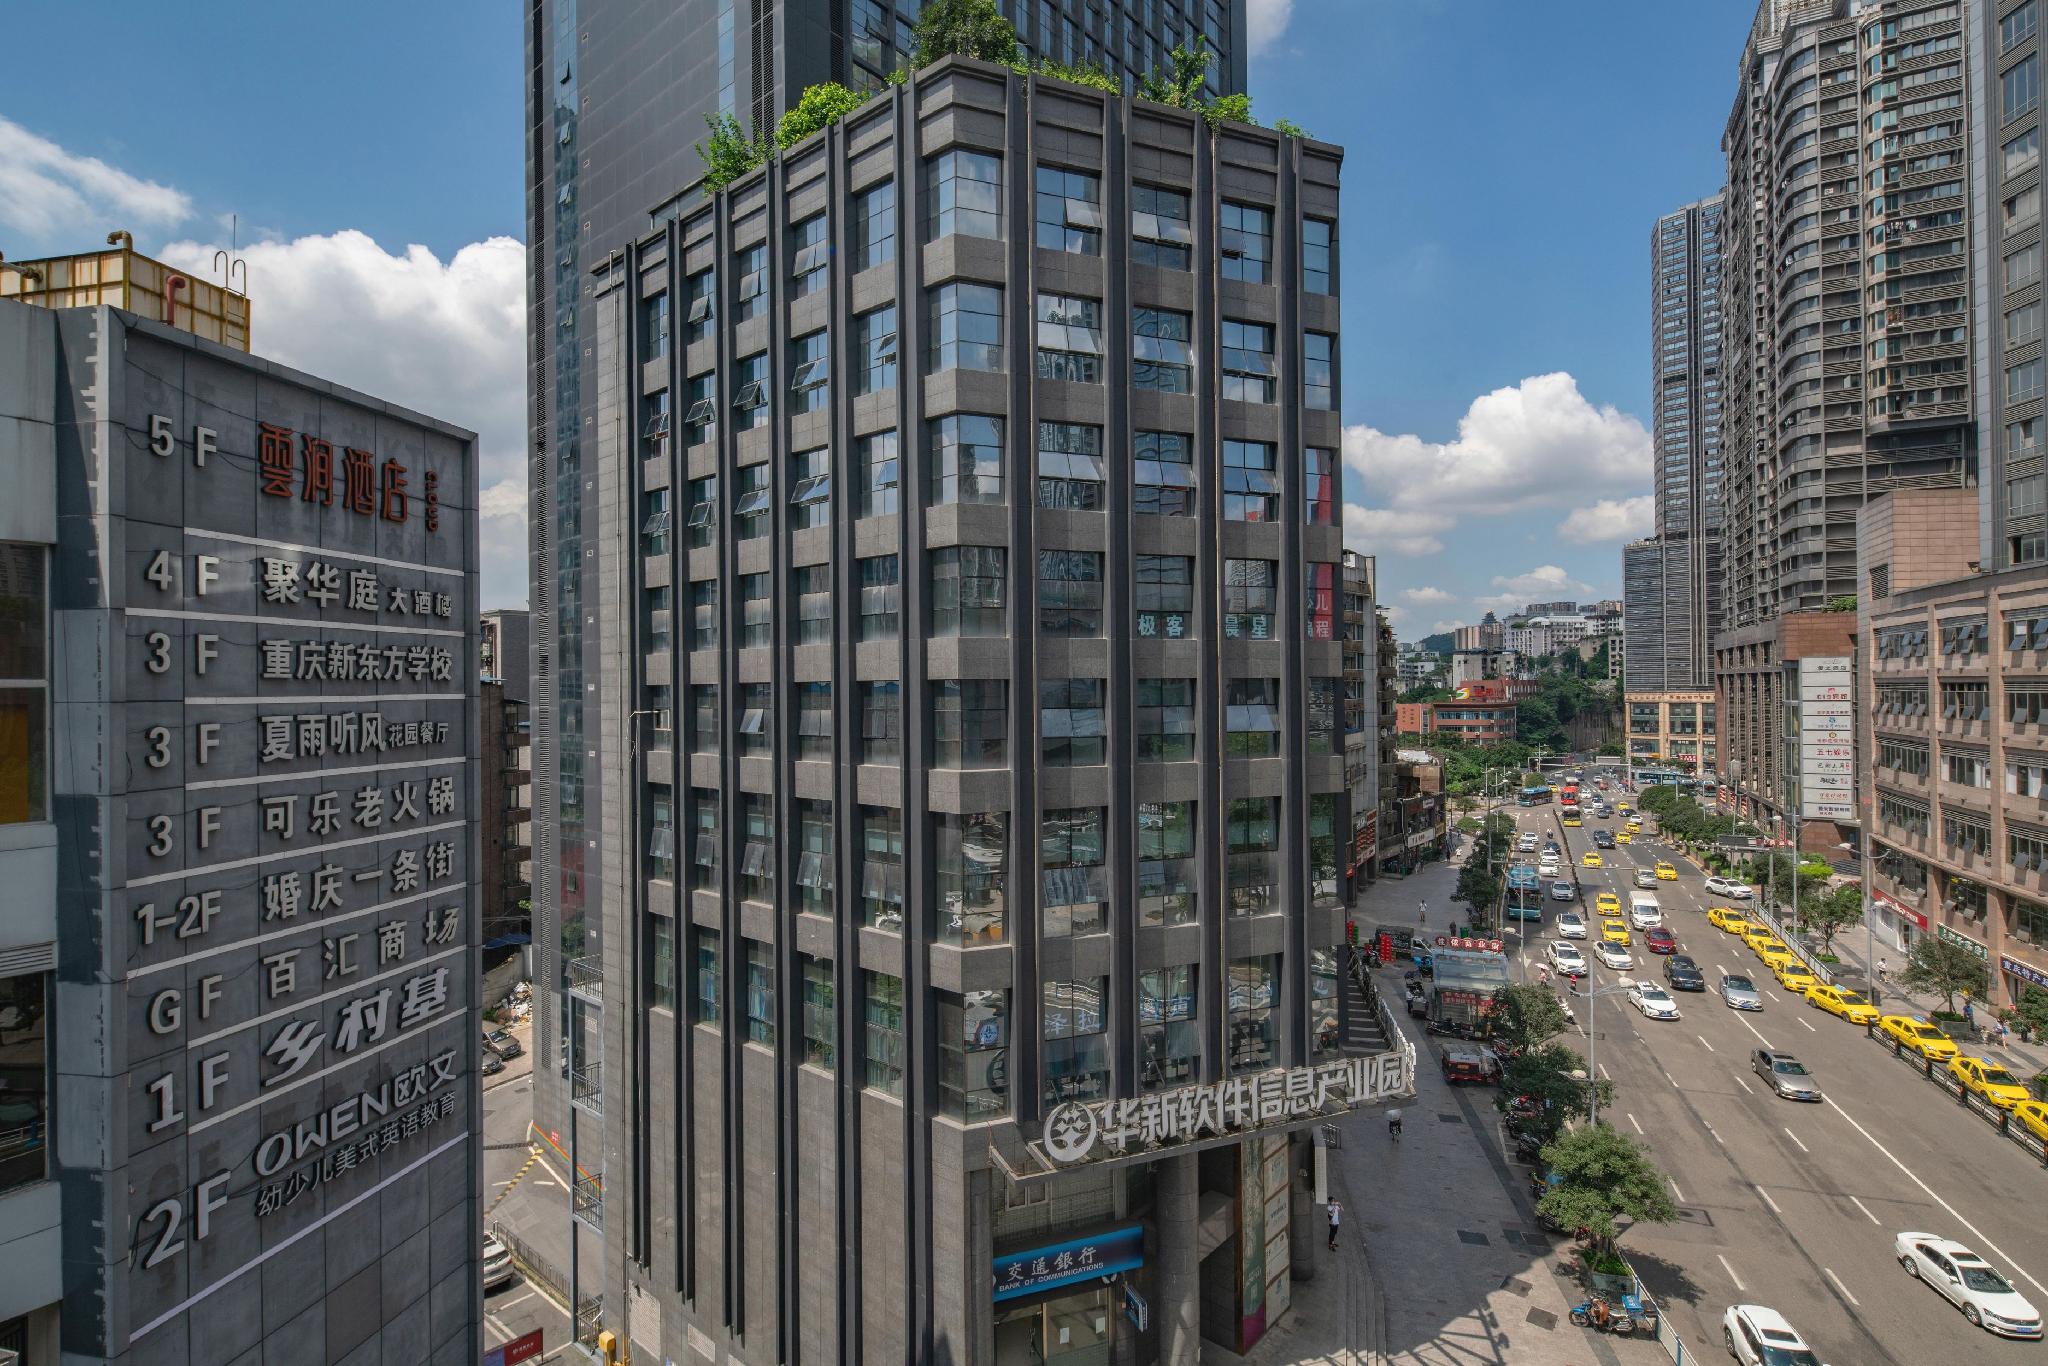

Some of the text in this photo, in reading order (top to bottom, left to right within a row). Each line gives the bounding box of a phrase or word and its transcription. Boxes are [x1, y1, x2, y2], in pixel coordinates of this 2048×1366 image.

[149, 414, 217, 467] 5F
[148, 550, 452, 617] 4F 聚华庭大酒楼
[147, 632, 453, 681] 3F 重庆新东方学校
[147, 712, 448, 768] 3F 夏雨听风花园餐厅
[149, 776, 456, 857] 3F 可乐老火锅
[137, 842, 456, 945] 1-2F 婚庆一条街
[149, 908, 460, 1034] GF 百汇商场
[147, 967, 450, 1133] 1F 乡村基
[1100, 1052, 1406, 1149] 华新软件信息产业园
[256, 1089, 458, 1218] 幼少儿美式英语教育
[143, 1170, 231, 1270] 2F
[999, 1262, 1104, 1292] BANK OF COMMUNICATIONS
